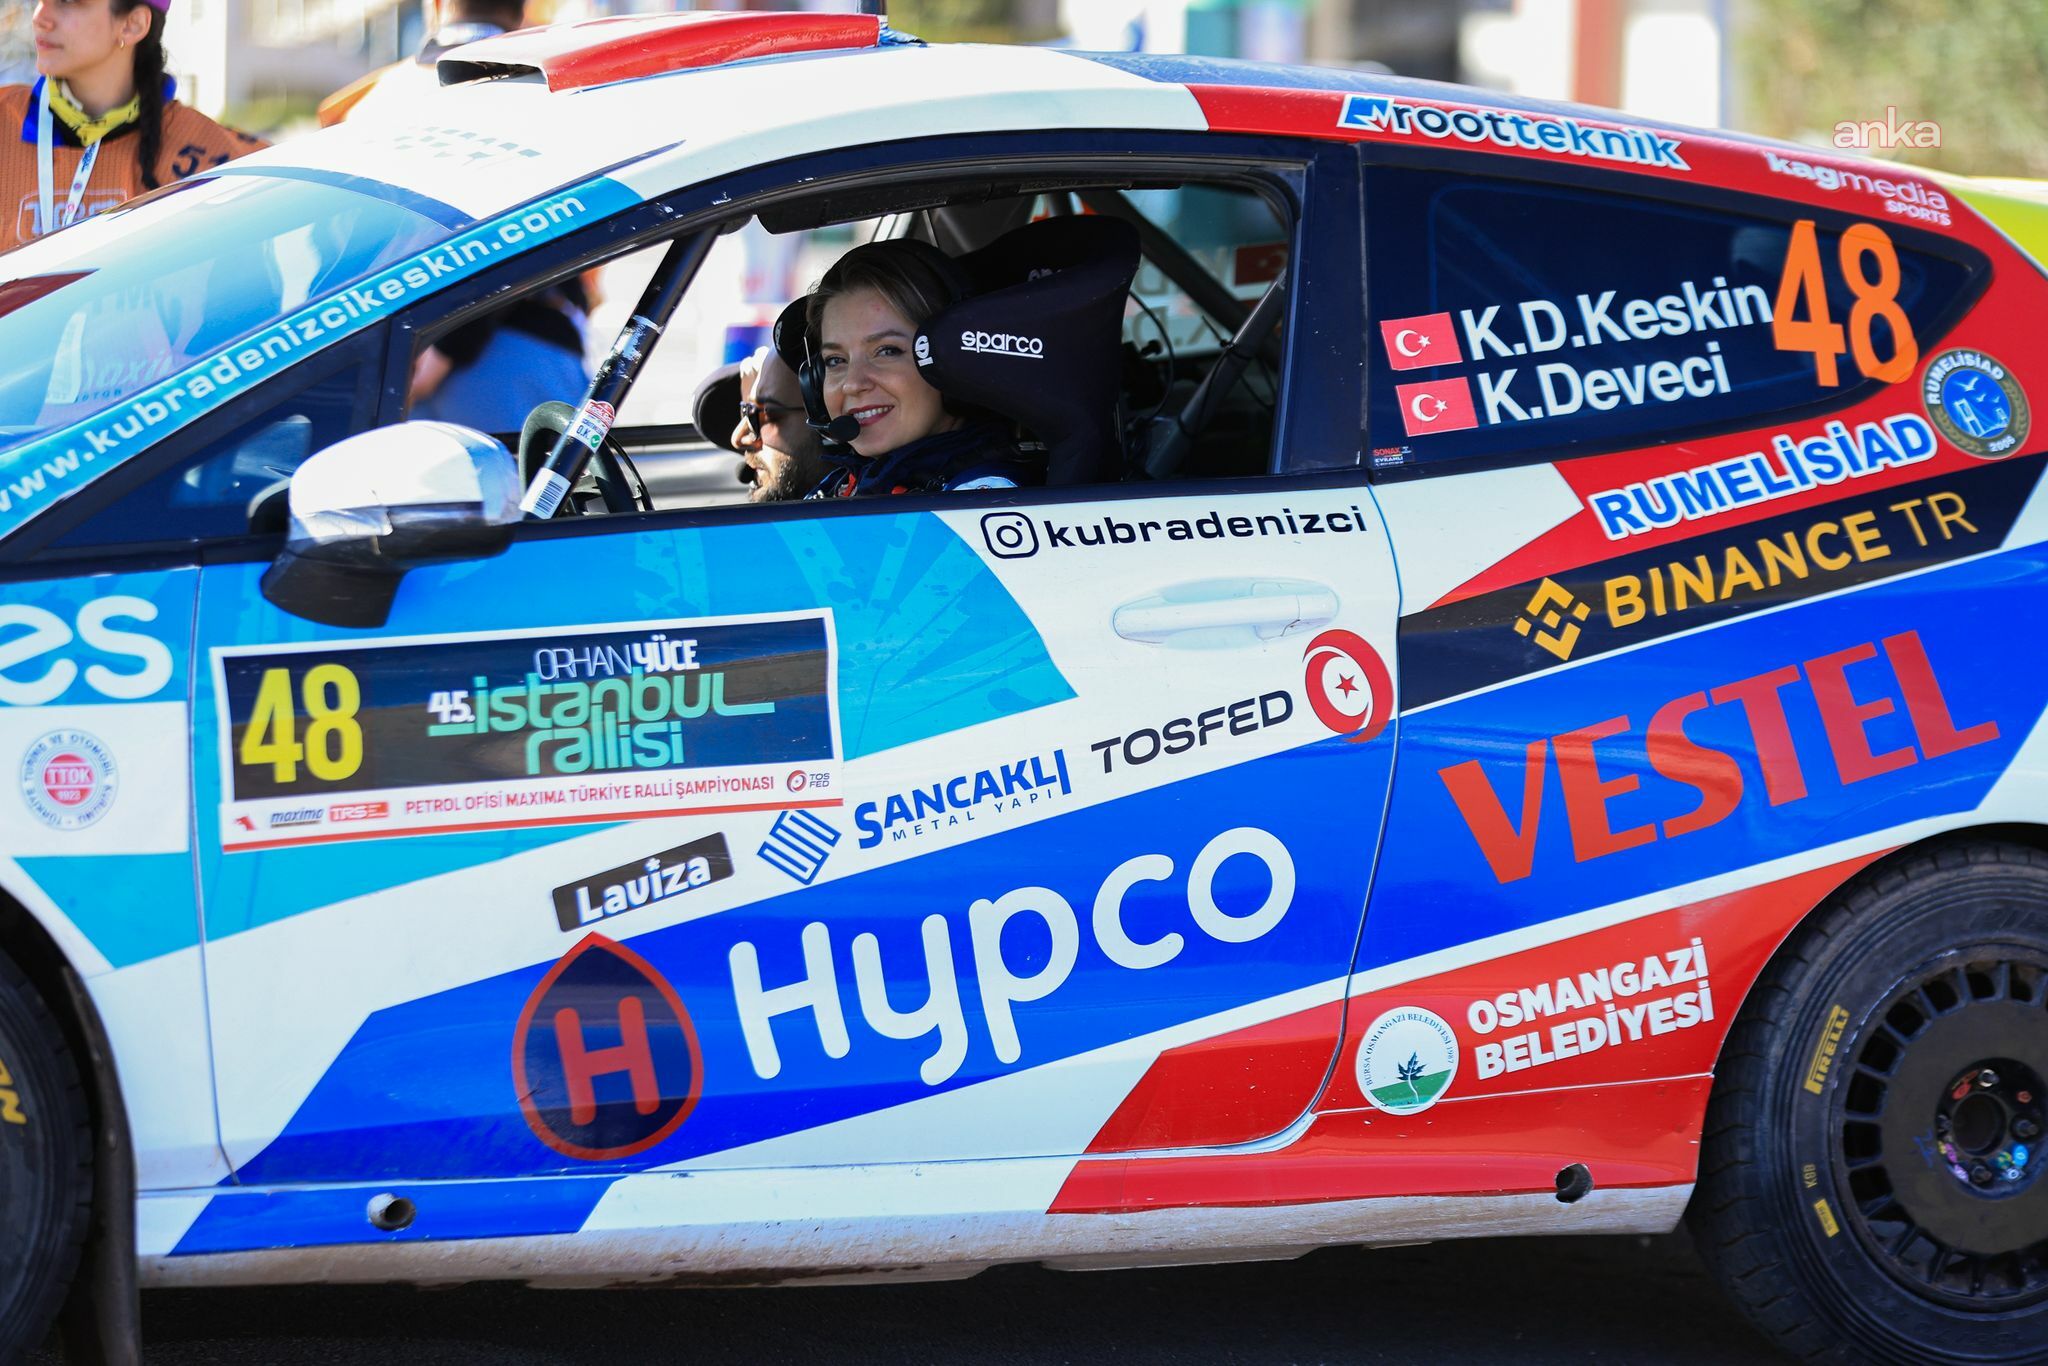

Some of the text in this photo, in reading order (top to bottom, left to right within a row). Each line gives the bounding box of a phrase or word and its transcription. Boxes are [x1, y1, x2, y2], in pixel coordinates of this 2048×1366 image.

[1390, 102, 1686, 167] rootteknik
[1763, 151, 1949, 210] kagmedia
[1885, 200, 1952, 226] SPORTS
[1460, 276, 1775, 361] K.D.Keskin
[1772, 219, 1919, 388] 48
[961, 330, 1043, 355] sparco
[1477, 341, 1732, 425] K.Deveci
[1590, 415, 1935, 538] RUMELİSİAD
[1044, 505, 1367, 548] kubradenizci
[1604, 491, 1979, 628] BINANCE TR
[536, 634, 700, 680] ORHAN YÜCE
[240, 664, 363, 784] 48
[427, 667, 775, 735] 45. istanbul
[1091, 690, 1294, 773] TOSFED
[525, 702, 685, 775] rallisi
[1438, 629, 2000, 885] VESTEL
[48, 767, 92, 785] TTOK
[406, 776, 774, 814] PETROL OFİSİ MAXIMA TÜRKİYE RALLİ ŞAMPİYONASI
[809, 772, 831, 781] TOS
[809, 780, 831, 788] FED
[854, 748, 1072, 849] SANCAKLI
[892, 789, 1052, 842] METAL YAPI
[729, 826, 1296, 1086] Hypco
[1467, 937, 1709, 1035] OSMANGAZİ
[1474, 980, 1714, 1080] BELEDİYESİ
[1804, 1004, 1850, 1095] PIRELLI
[1363, 1057, 1374, 1087] BURSA
